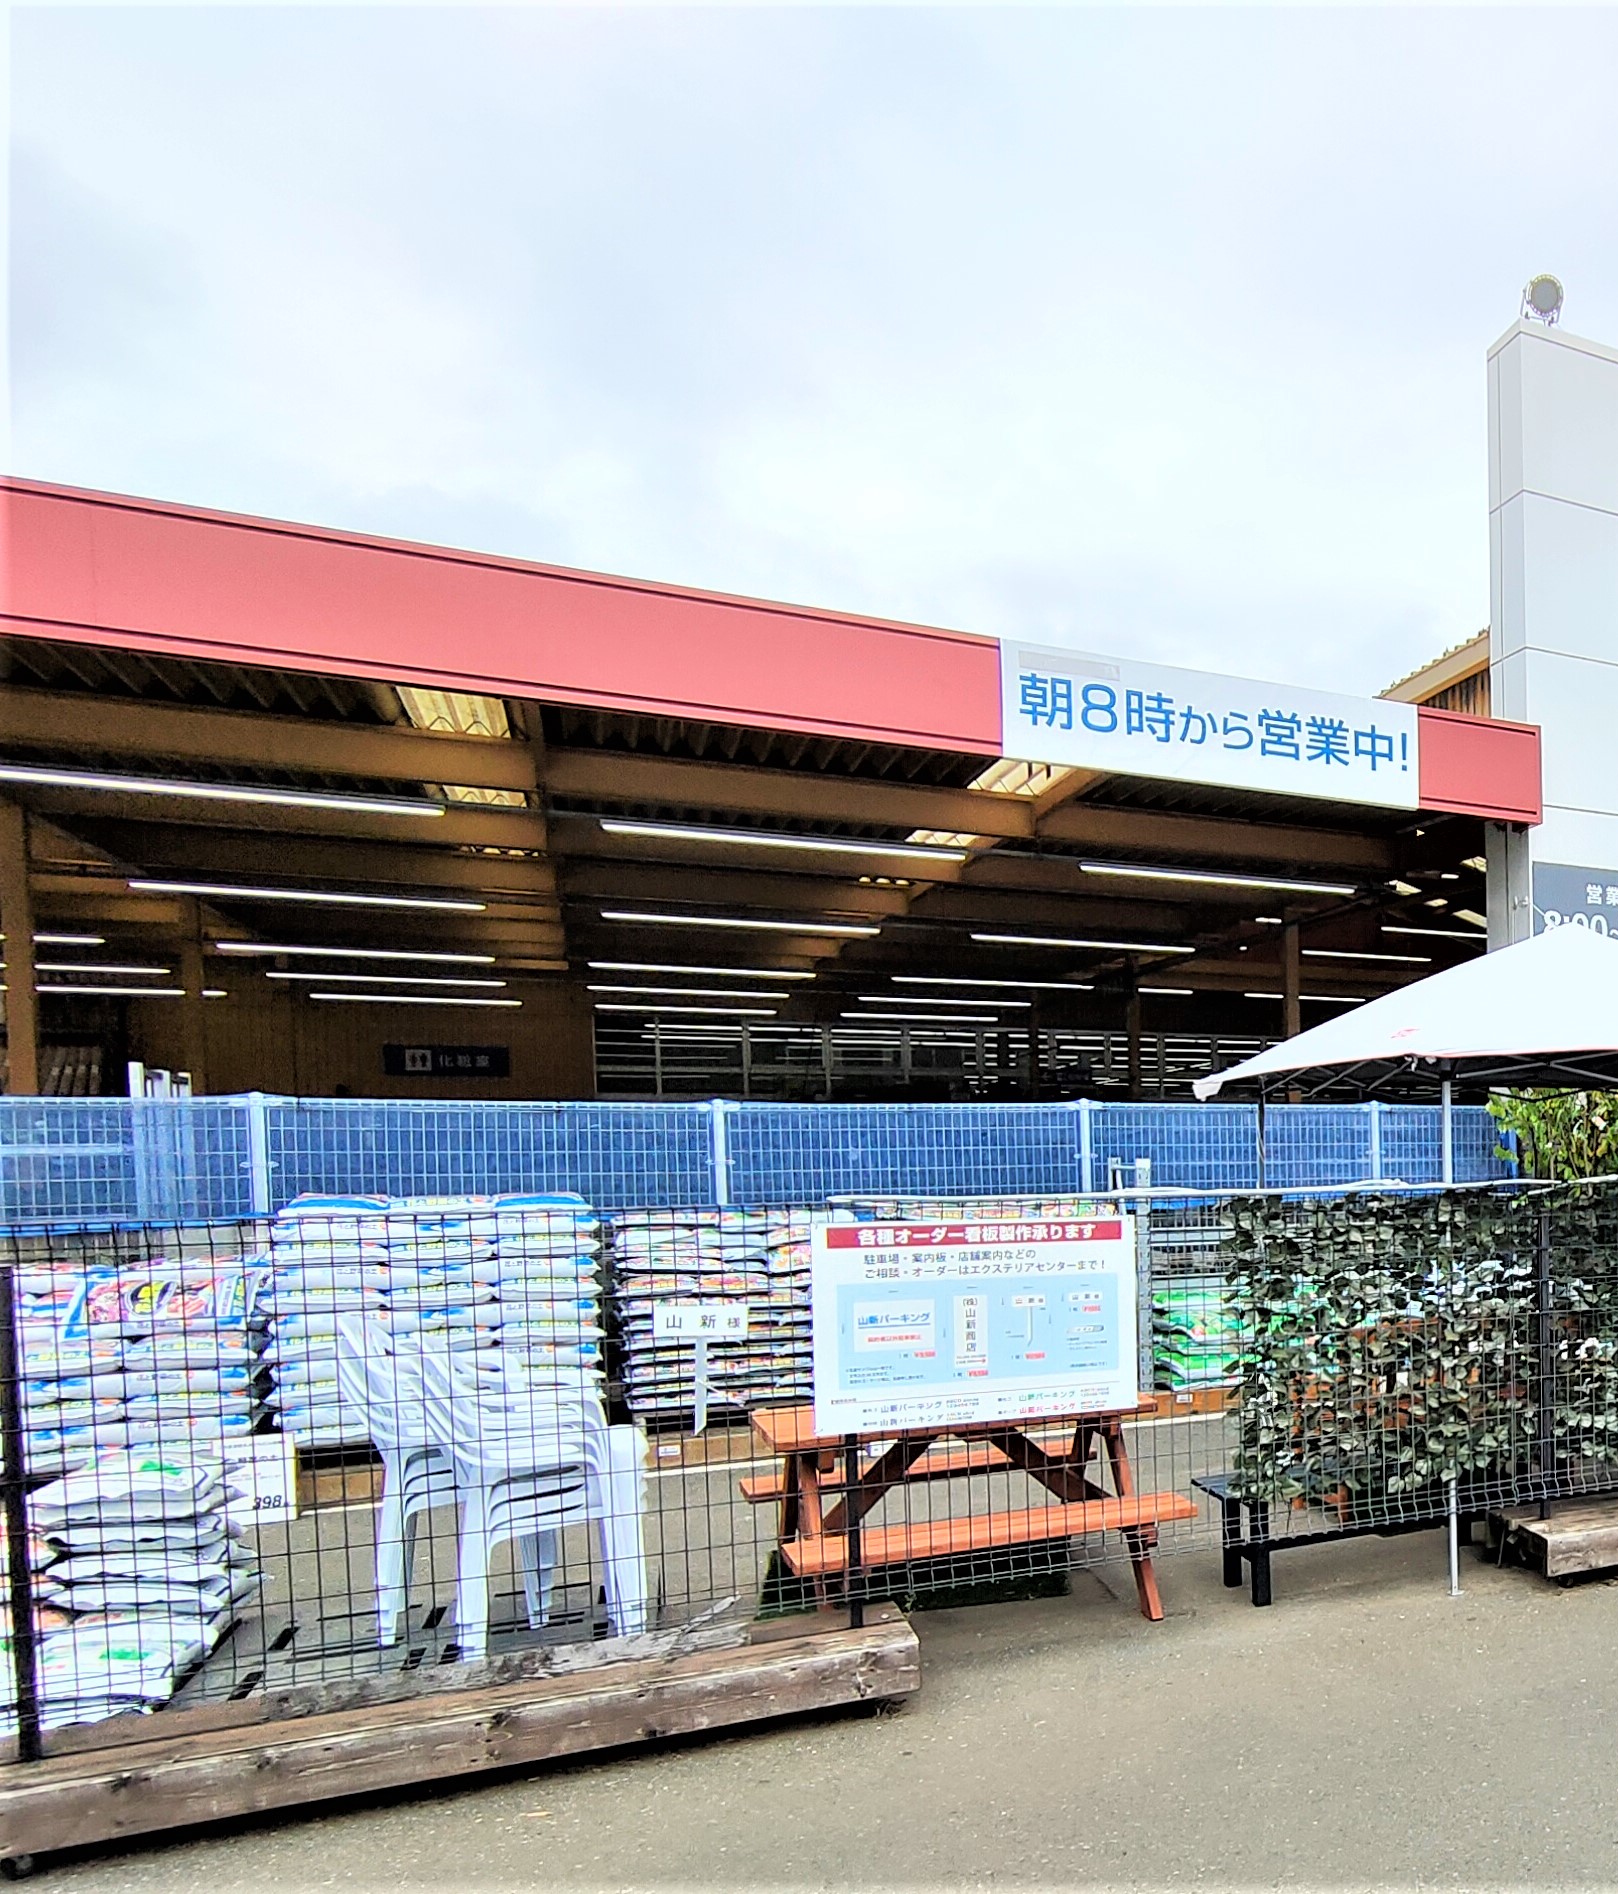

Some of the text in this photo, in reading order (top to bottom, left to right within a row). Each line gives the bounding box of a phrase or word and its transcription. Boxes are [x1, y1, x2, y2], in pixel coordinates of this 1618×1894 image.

[1018, 672, 1408, 771] 朝8時から営業中!
[857, 1222, 1096, 1247] 各種オーダー看板製作承ります
[857, 1311, 931, 1326] 山新パーキング
